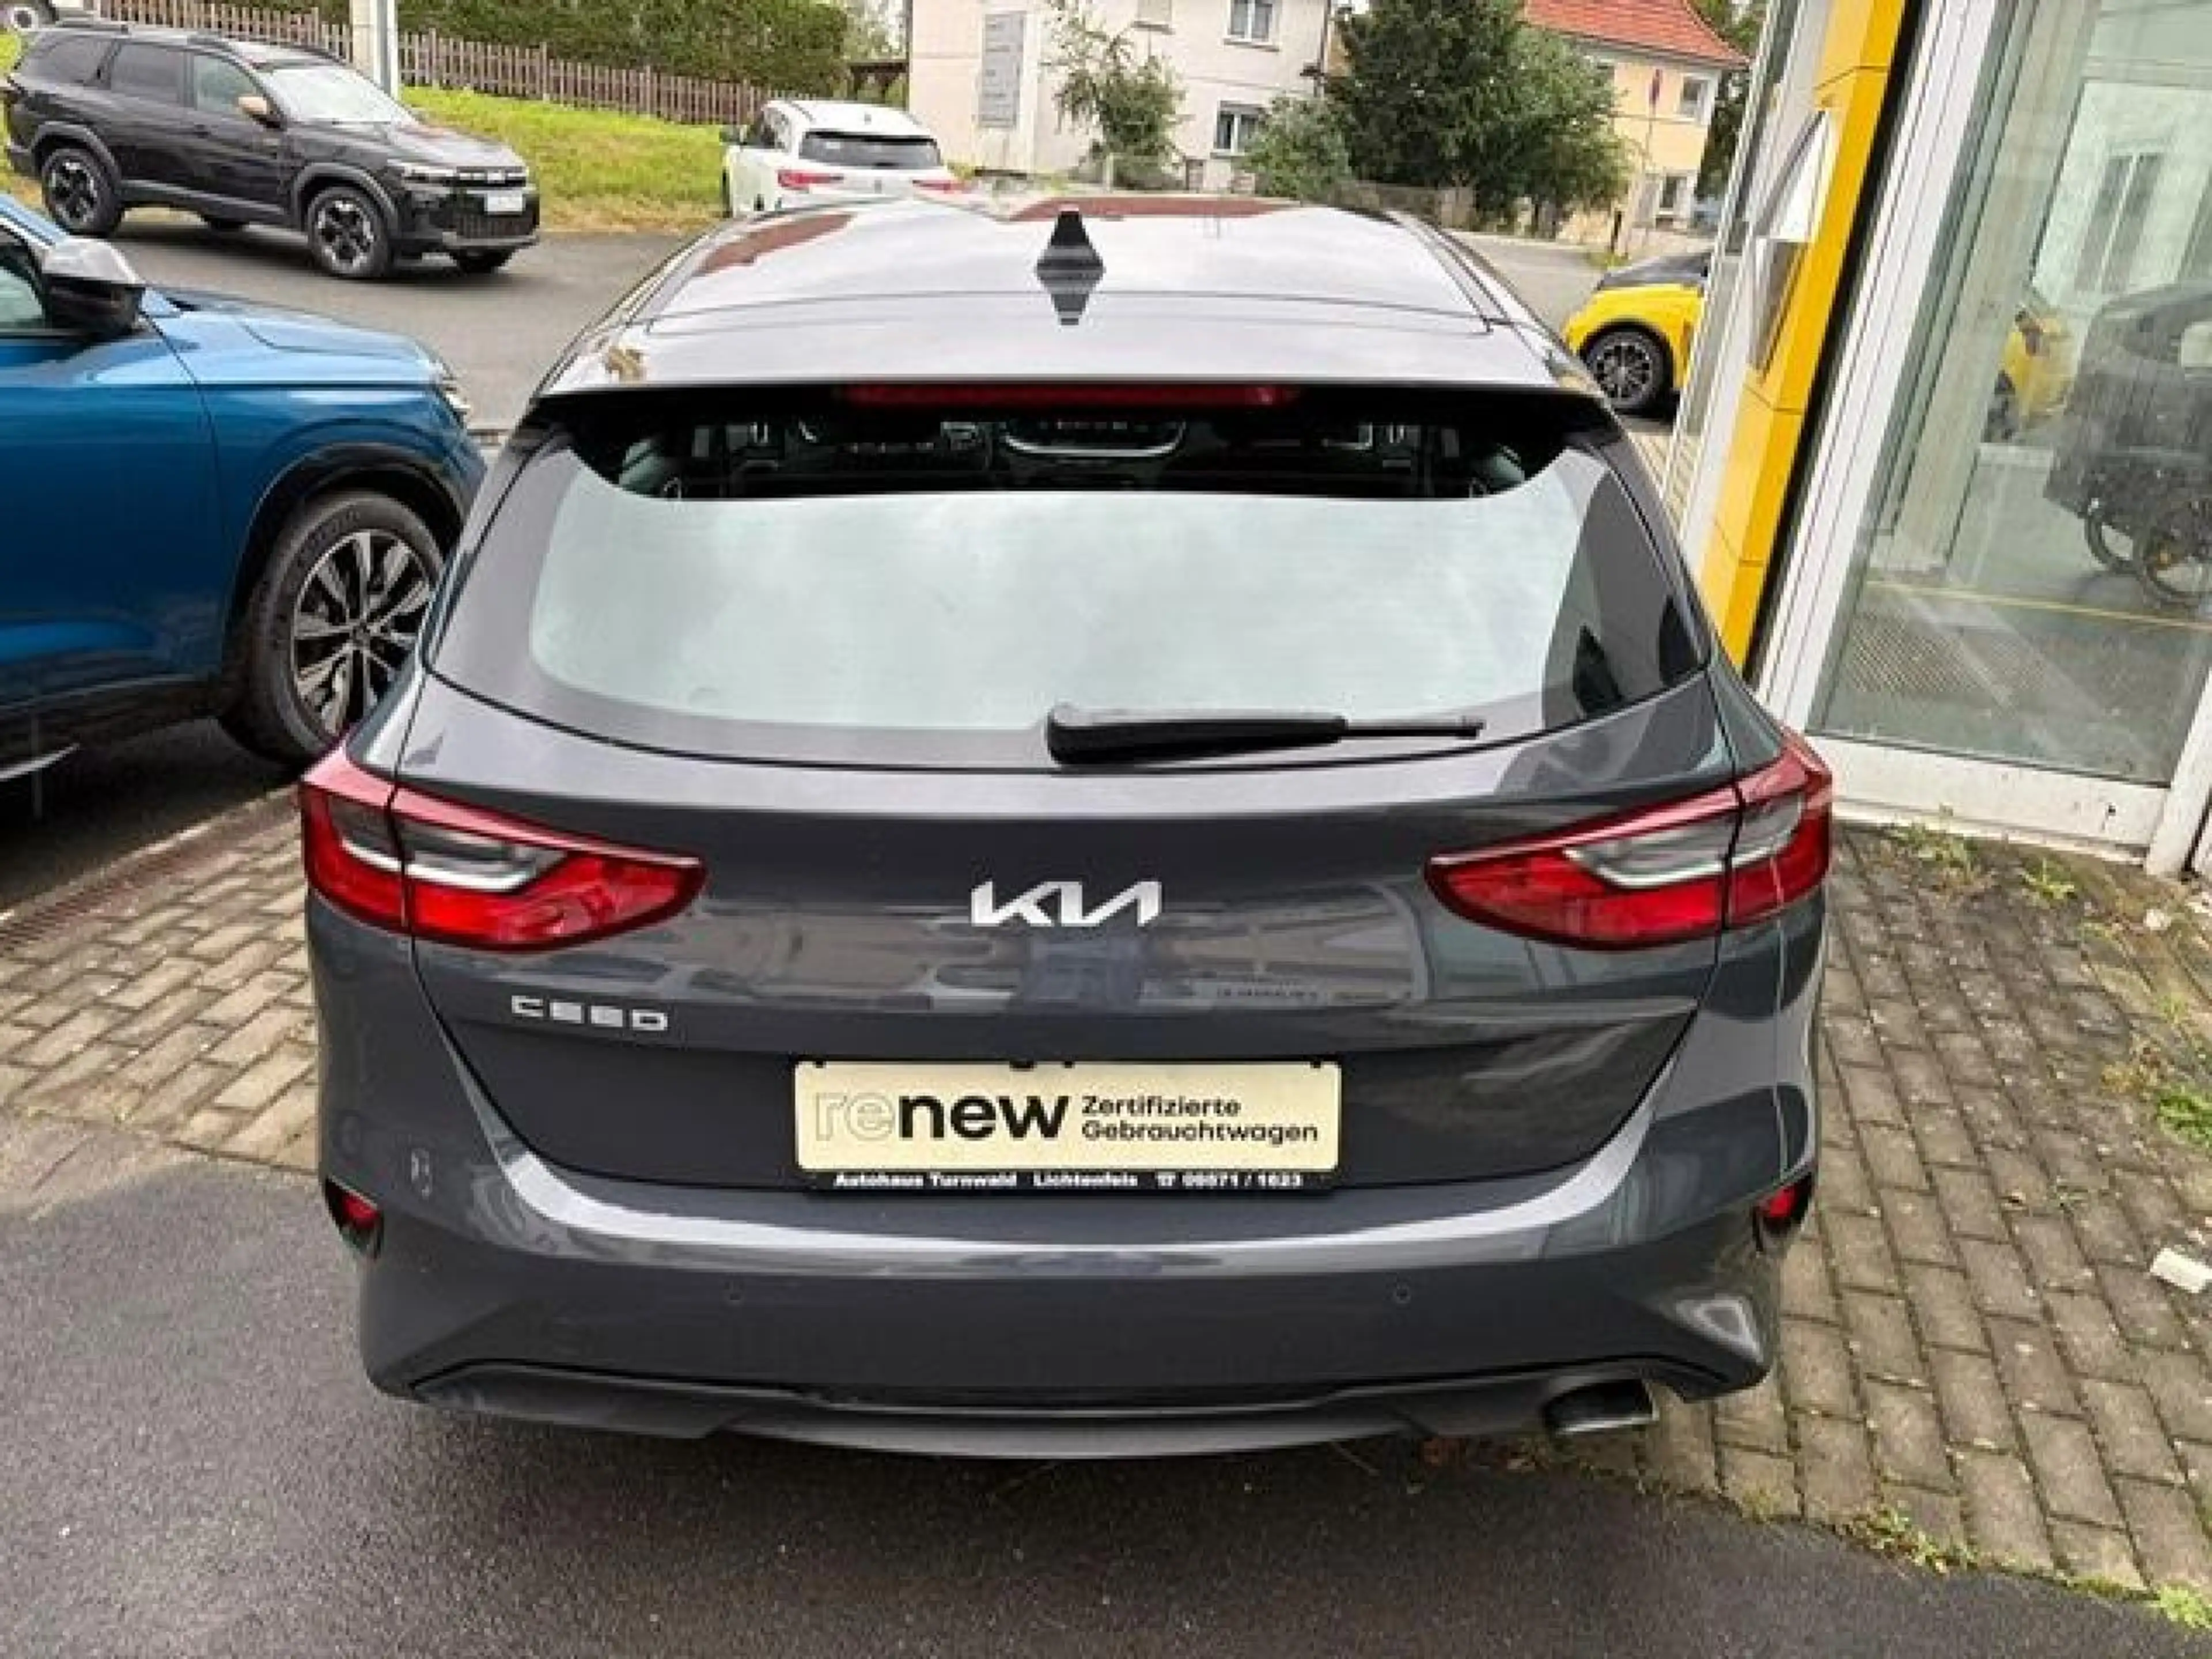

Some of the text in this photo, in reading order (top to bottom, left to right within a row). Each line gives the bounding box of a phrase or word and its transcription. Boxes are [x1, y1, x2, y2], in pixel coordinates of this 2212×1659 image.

[971, 881, 1161, 927] KIA
[512, 995, 668, 1031] CEED
[816, 1092, 1070, 1141] renew
[1082, 1096, 1241, 1116] Zertifizierte
[1082, 1120, 1318, 1145] Gebrauchtwagen
